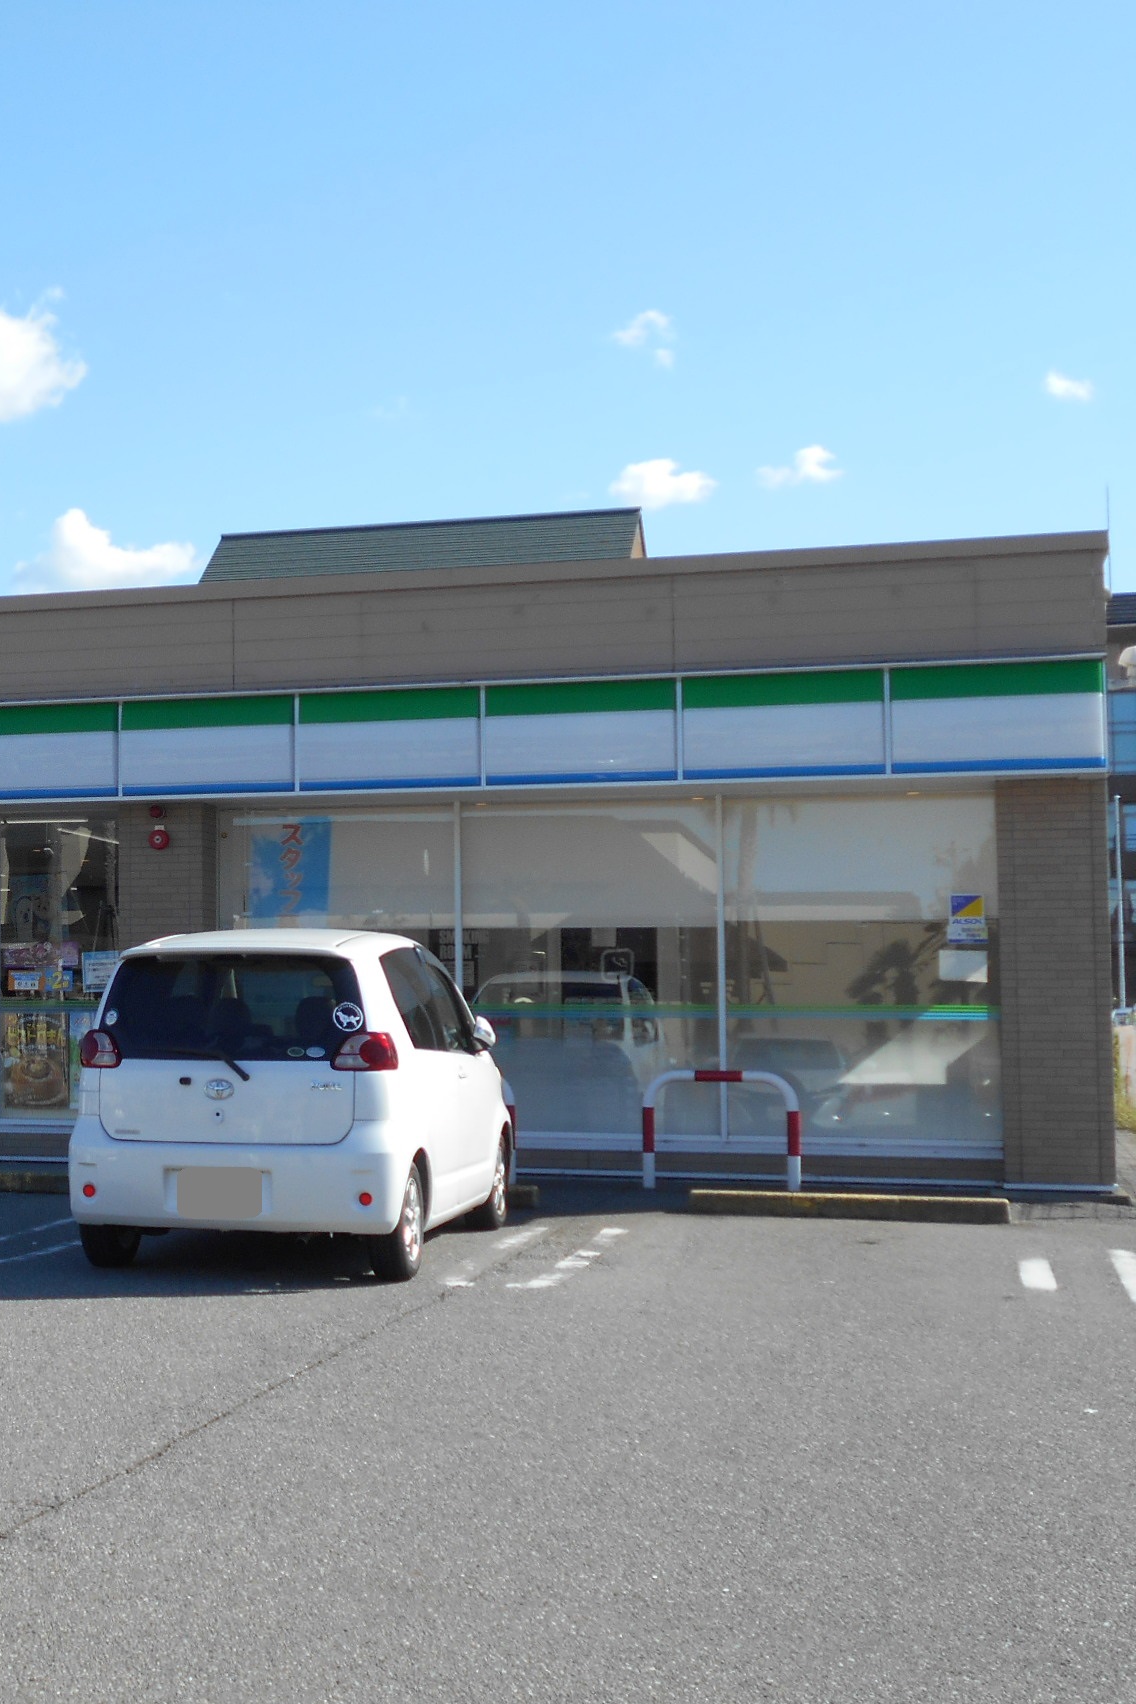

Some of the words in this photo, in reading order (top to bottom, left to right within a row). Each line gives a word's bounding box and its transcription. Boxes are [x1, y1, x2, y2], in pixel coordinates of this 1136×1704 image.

[280, 824, 304, 917] スタッフ
[440, 929, 489, 944] SMKING
[440, 945, 472, 959] ROM
